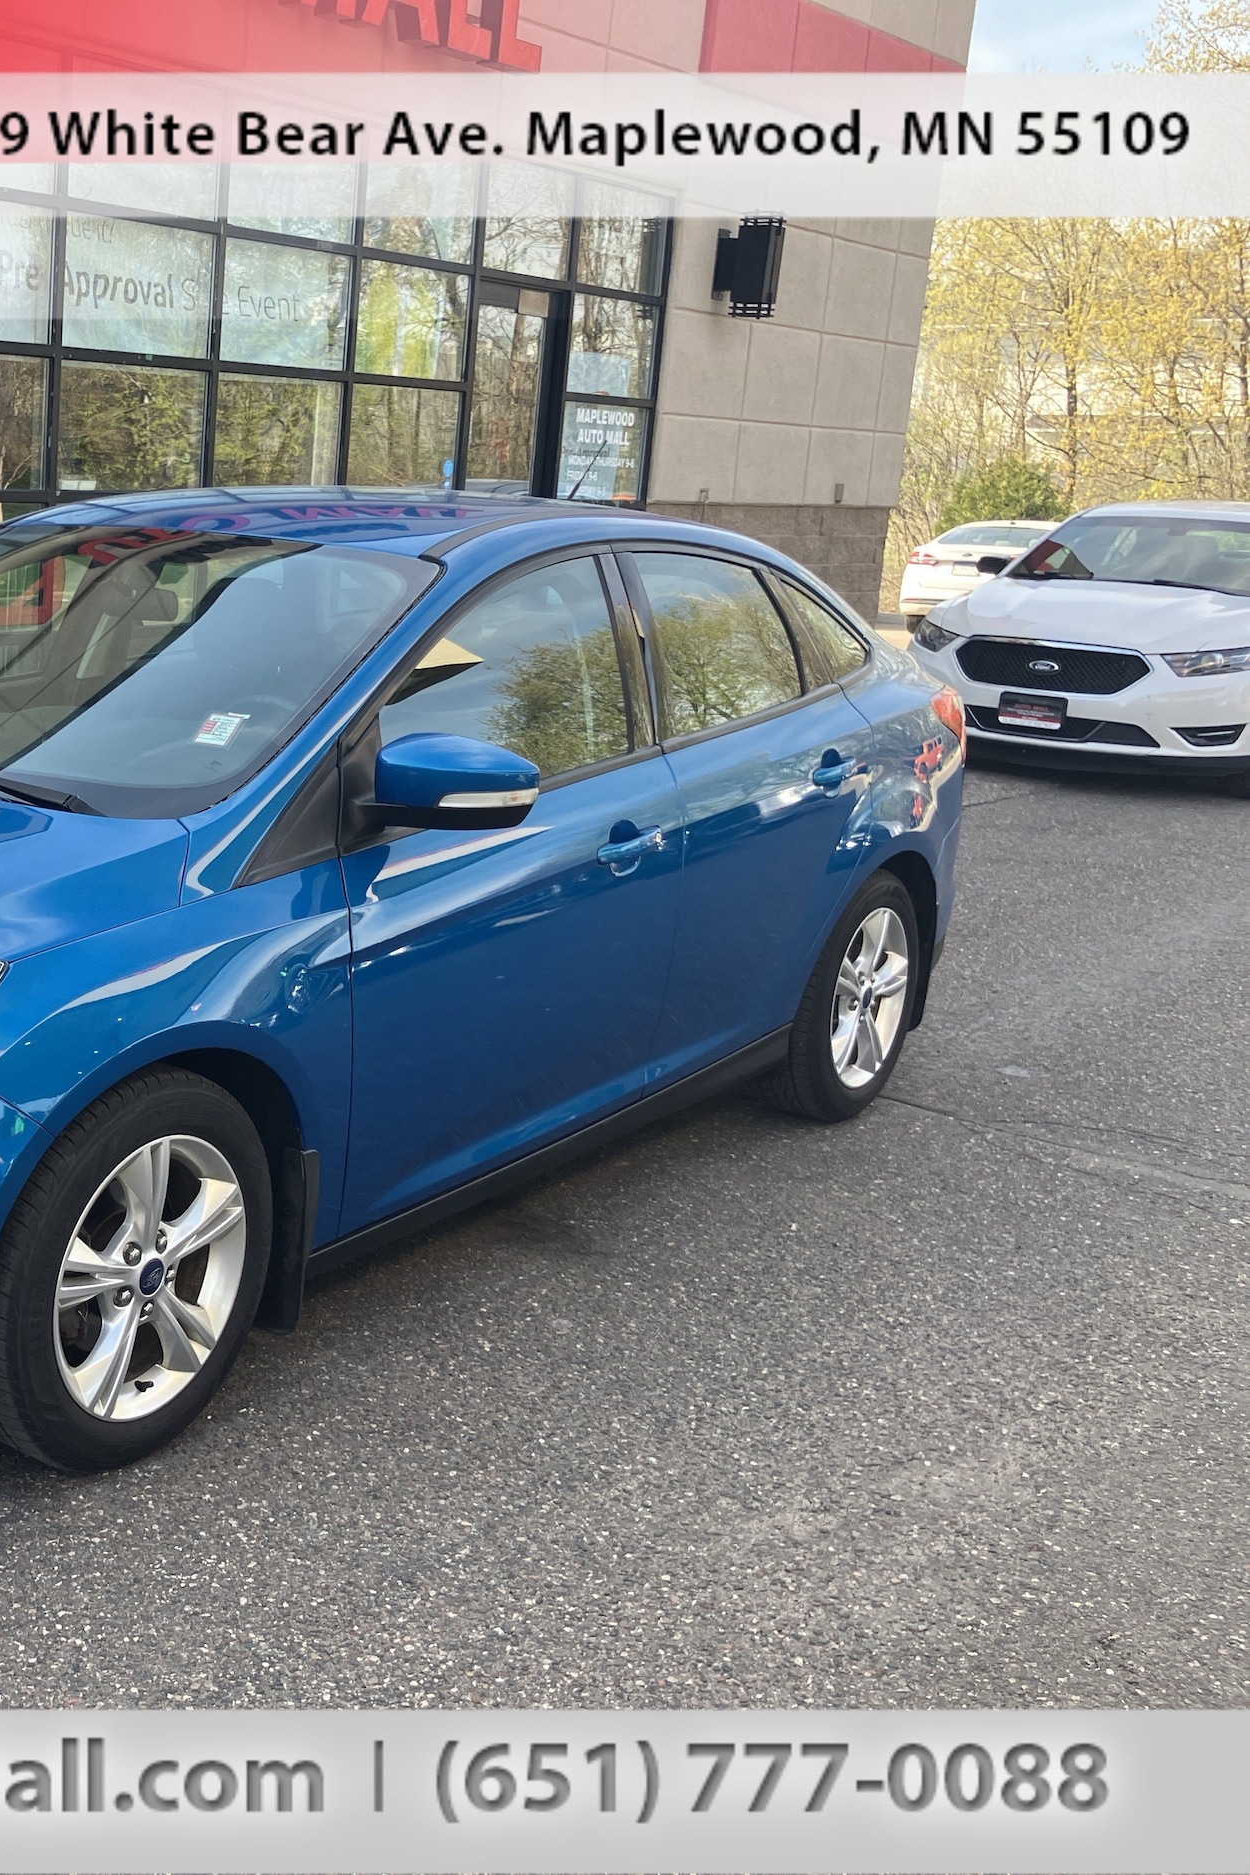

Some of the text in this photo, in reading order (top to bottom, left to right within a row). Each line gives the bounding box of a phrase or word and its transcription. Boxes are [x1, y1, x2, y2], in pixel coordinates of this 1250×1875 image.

[237, 285, 301, 323] Event
[576, 407, 635, 427] MAPLEWOOD
[577, 428, 630, 446] AUTO MALL
